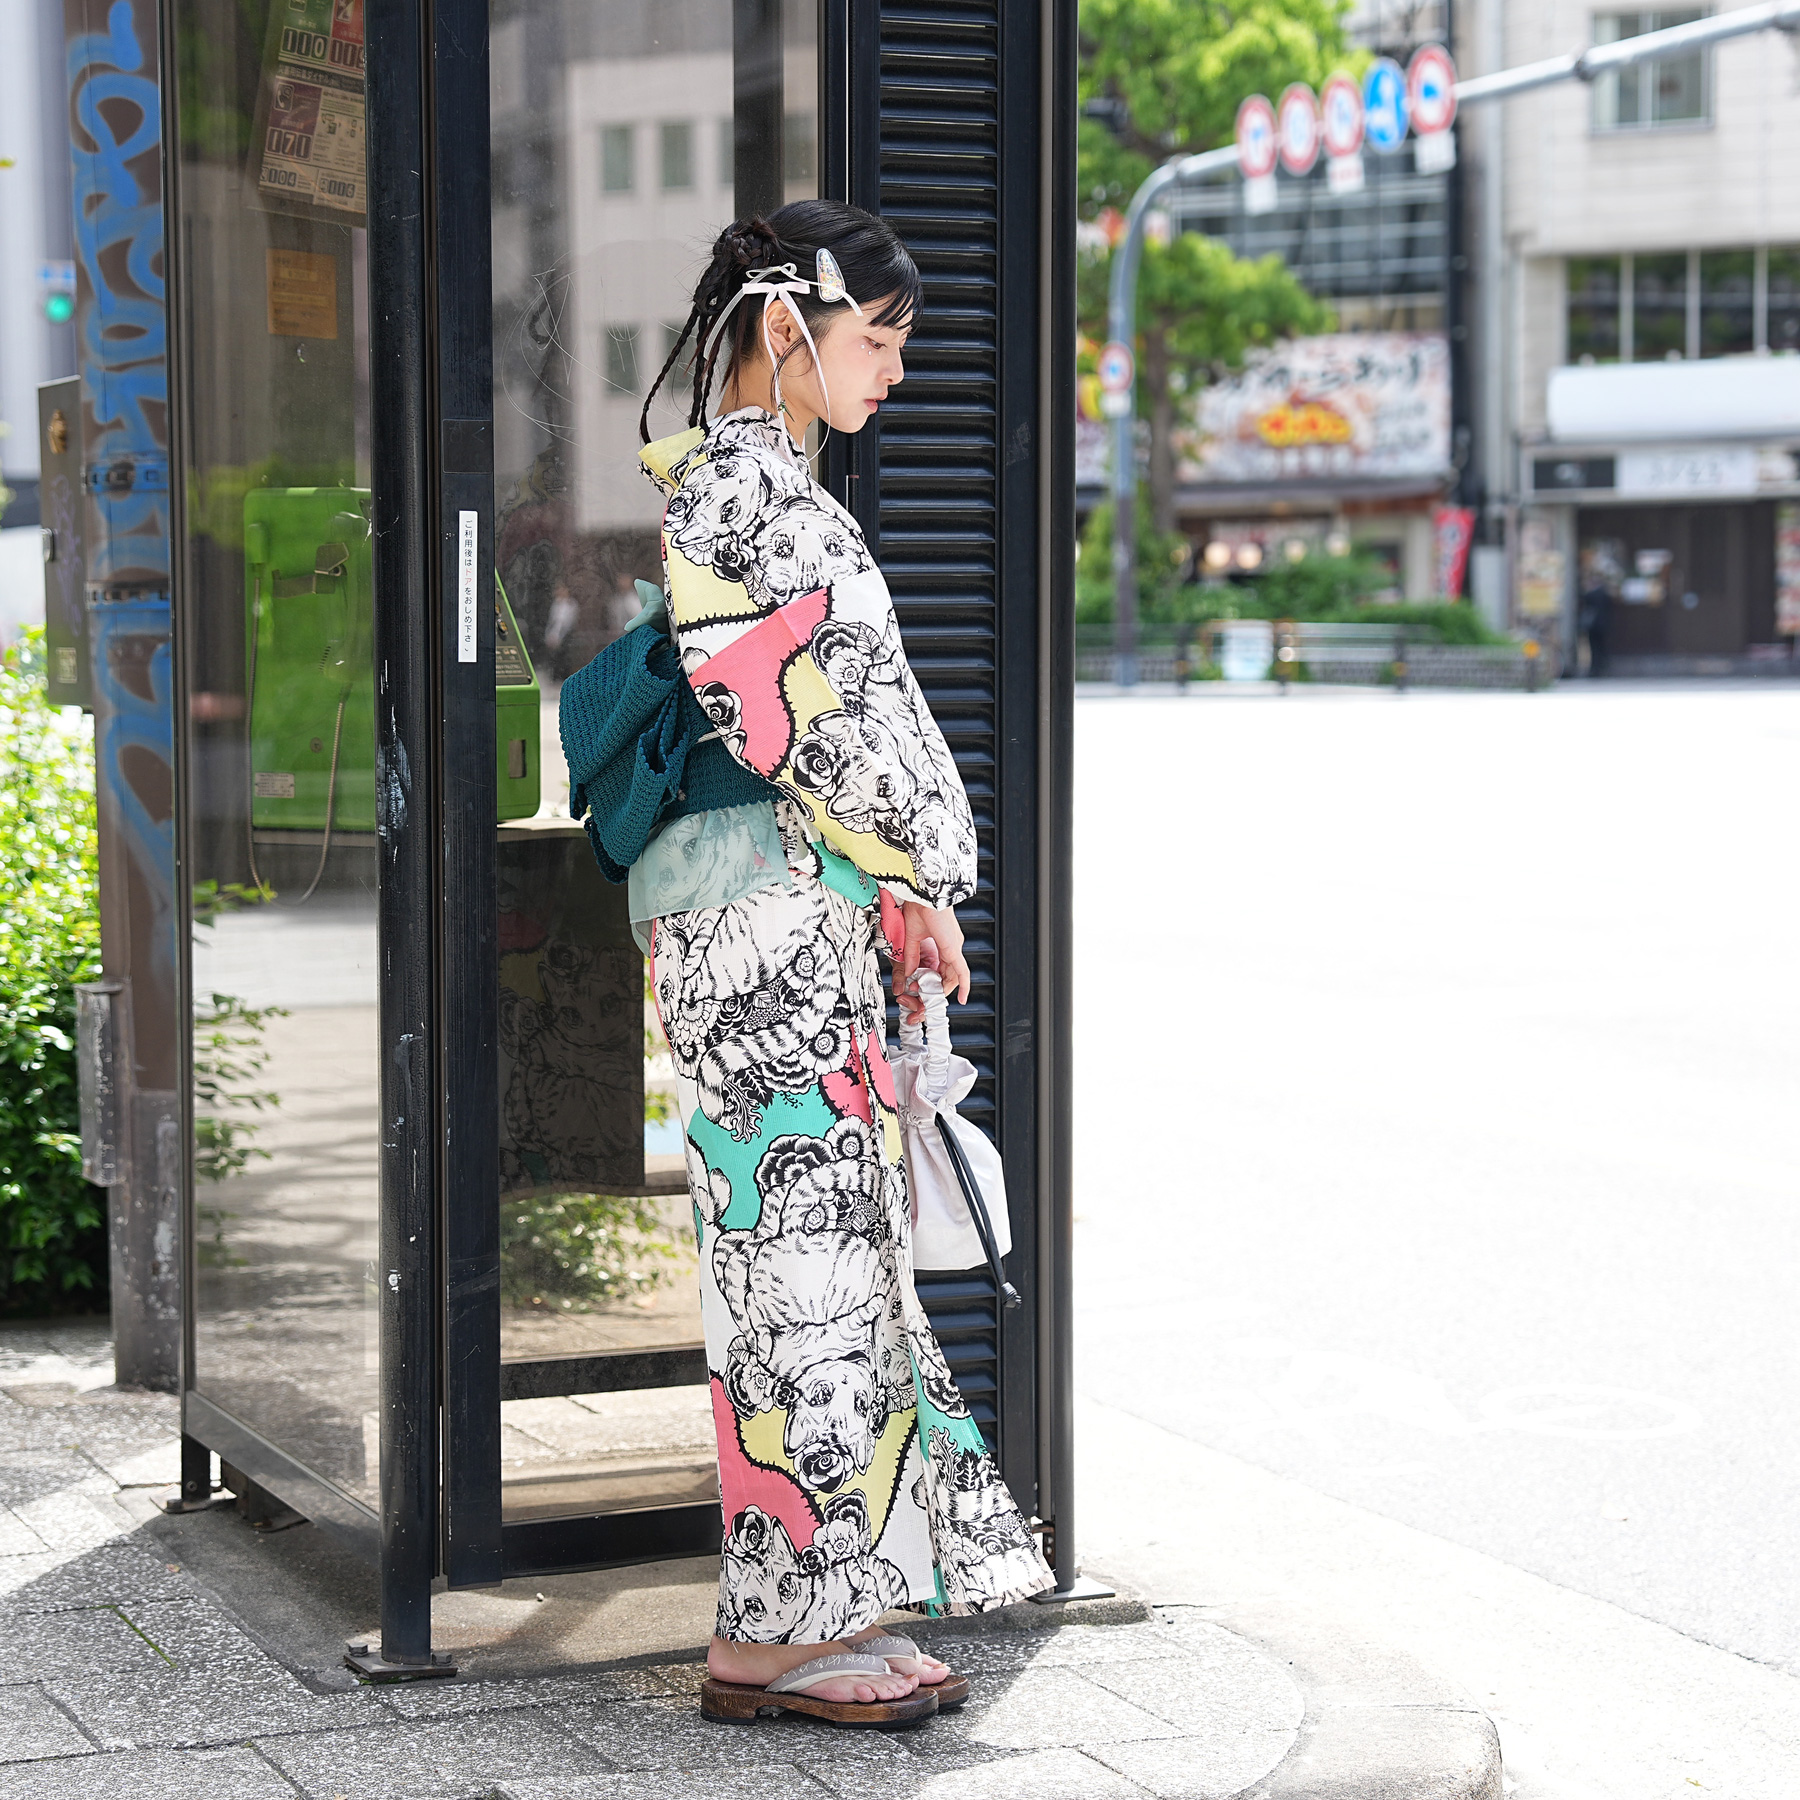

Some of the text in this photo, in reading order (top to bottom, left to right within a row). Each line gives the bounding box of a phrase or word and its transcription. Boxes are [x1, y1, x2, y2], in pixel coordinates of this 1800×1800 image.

[286, 29, 326, 59] 110
[271, 130, 306, 158] 171
[269, 168, 297, 187] 104
[329, 180, 355, 198] 116
